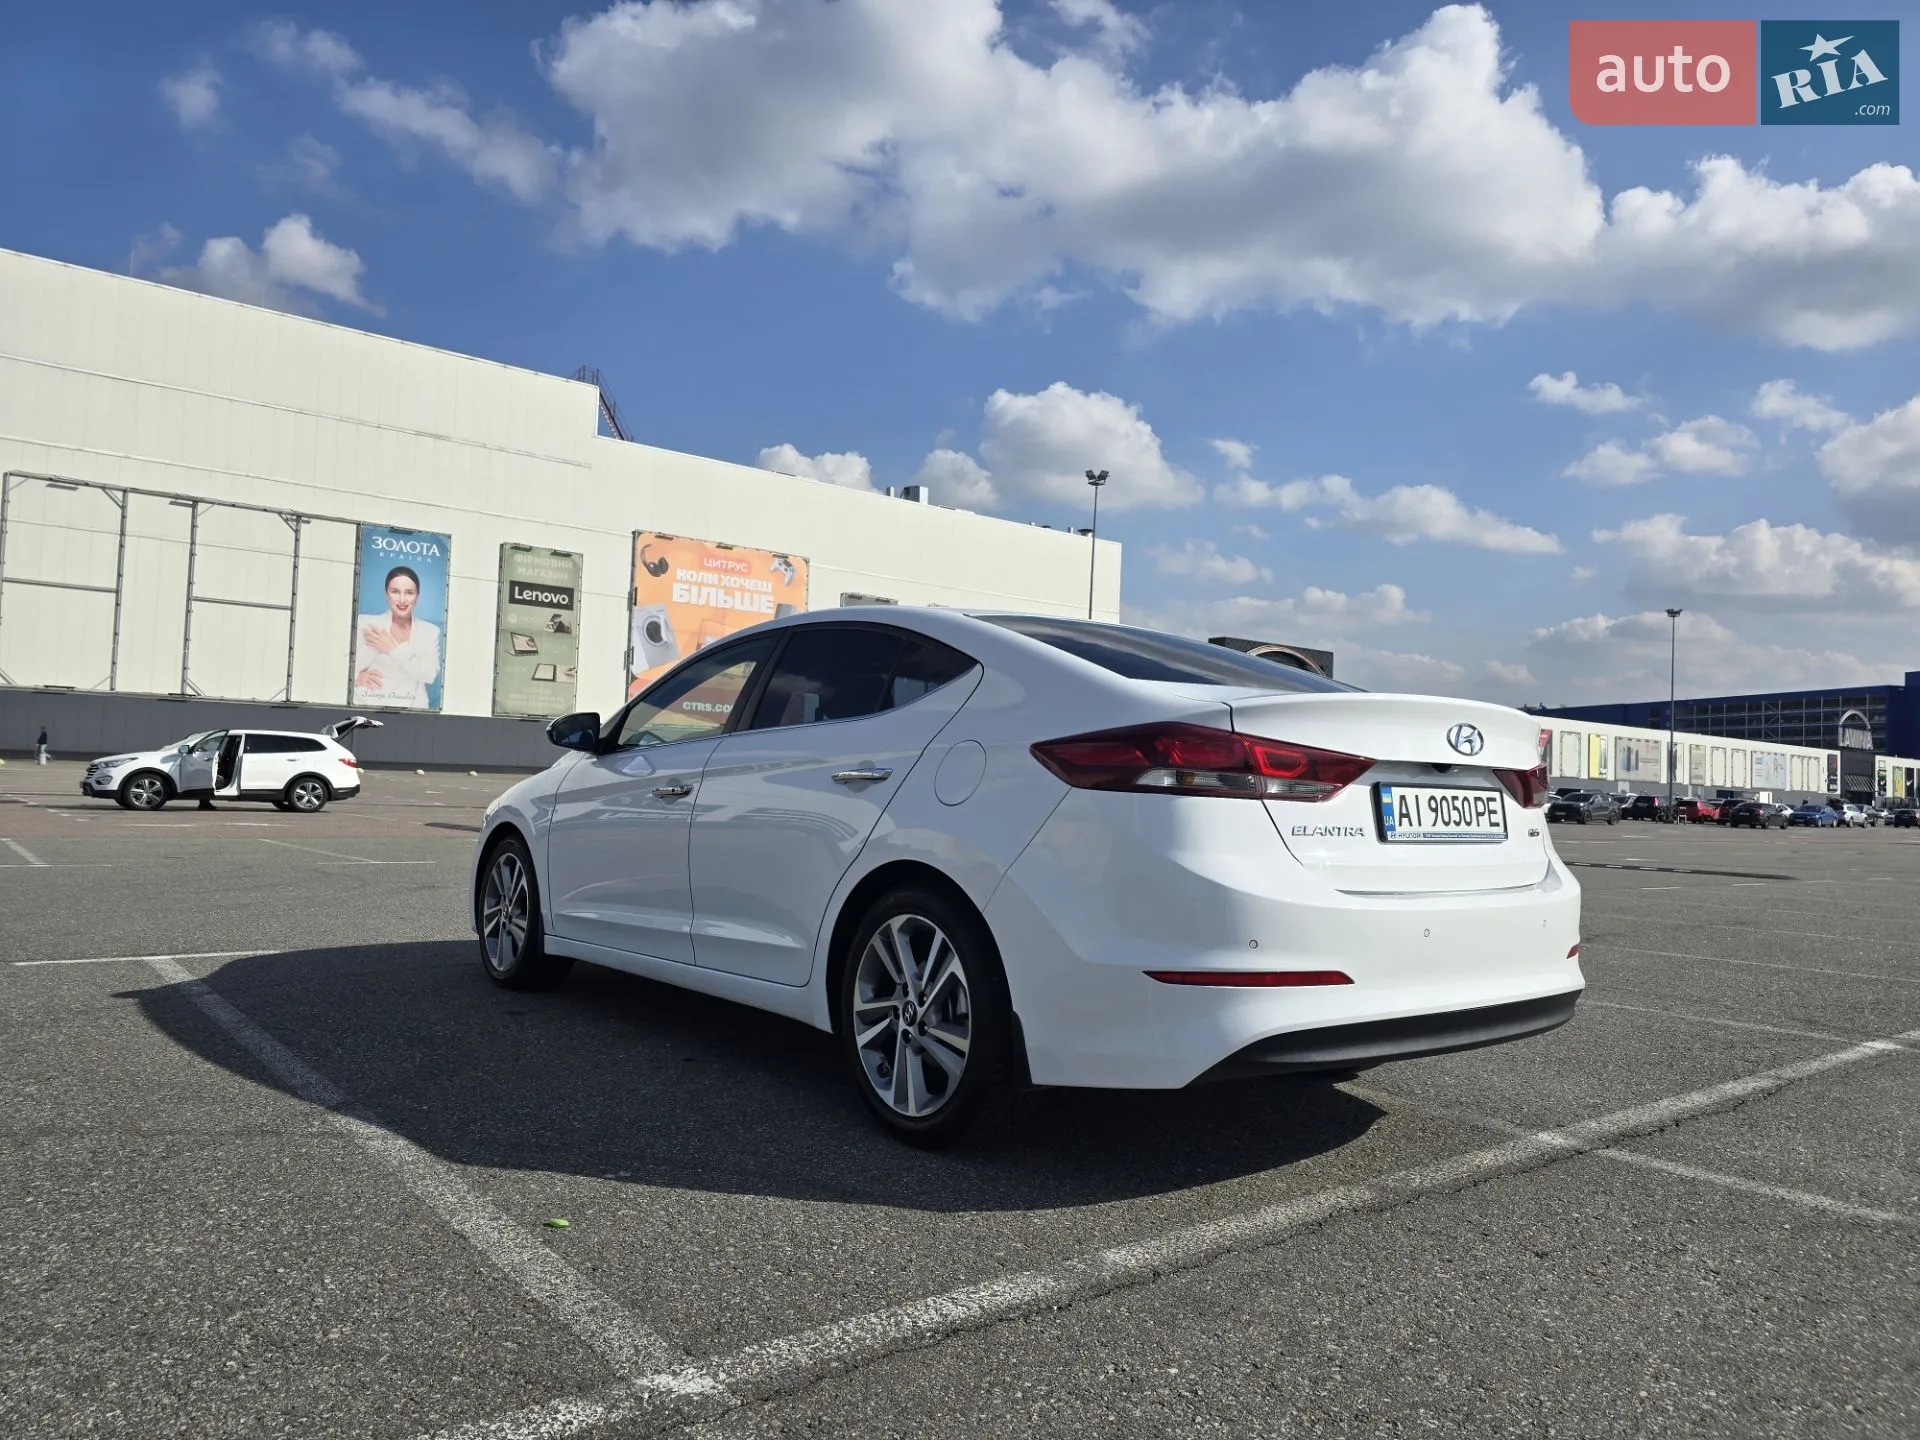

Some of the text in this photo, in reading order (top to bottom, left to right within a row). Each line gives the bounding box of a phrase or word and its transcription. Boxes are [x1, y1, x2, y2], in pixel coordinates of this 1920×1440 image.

[371, 536, 440, 557] ЗОЛОТА
[703, 557, 748, 573] ЦИТРУС
[676, 568, 773, 592] КОЛИ ХОЧЕШ
[514, 586, 569, 605] Lenovo
[672, 583, 775, 614] БІЛЬШЕ
[682, 701, 734, 713] CTRS.CO
[1398, 794, 1422, 827] AI
[1383, 816, 1395, 826] UA
[1291, 825, 1365, 837] ELANTRA
